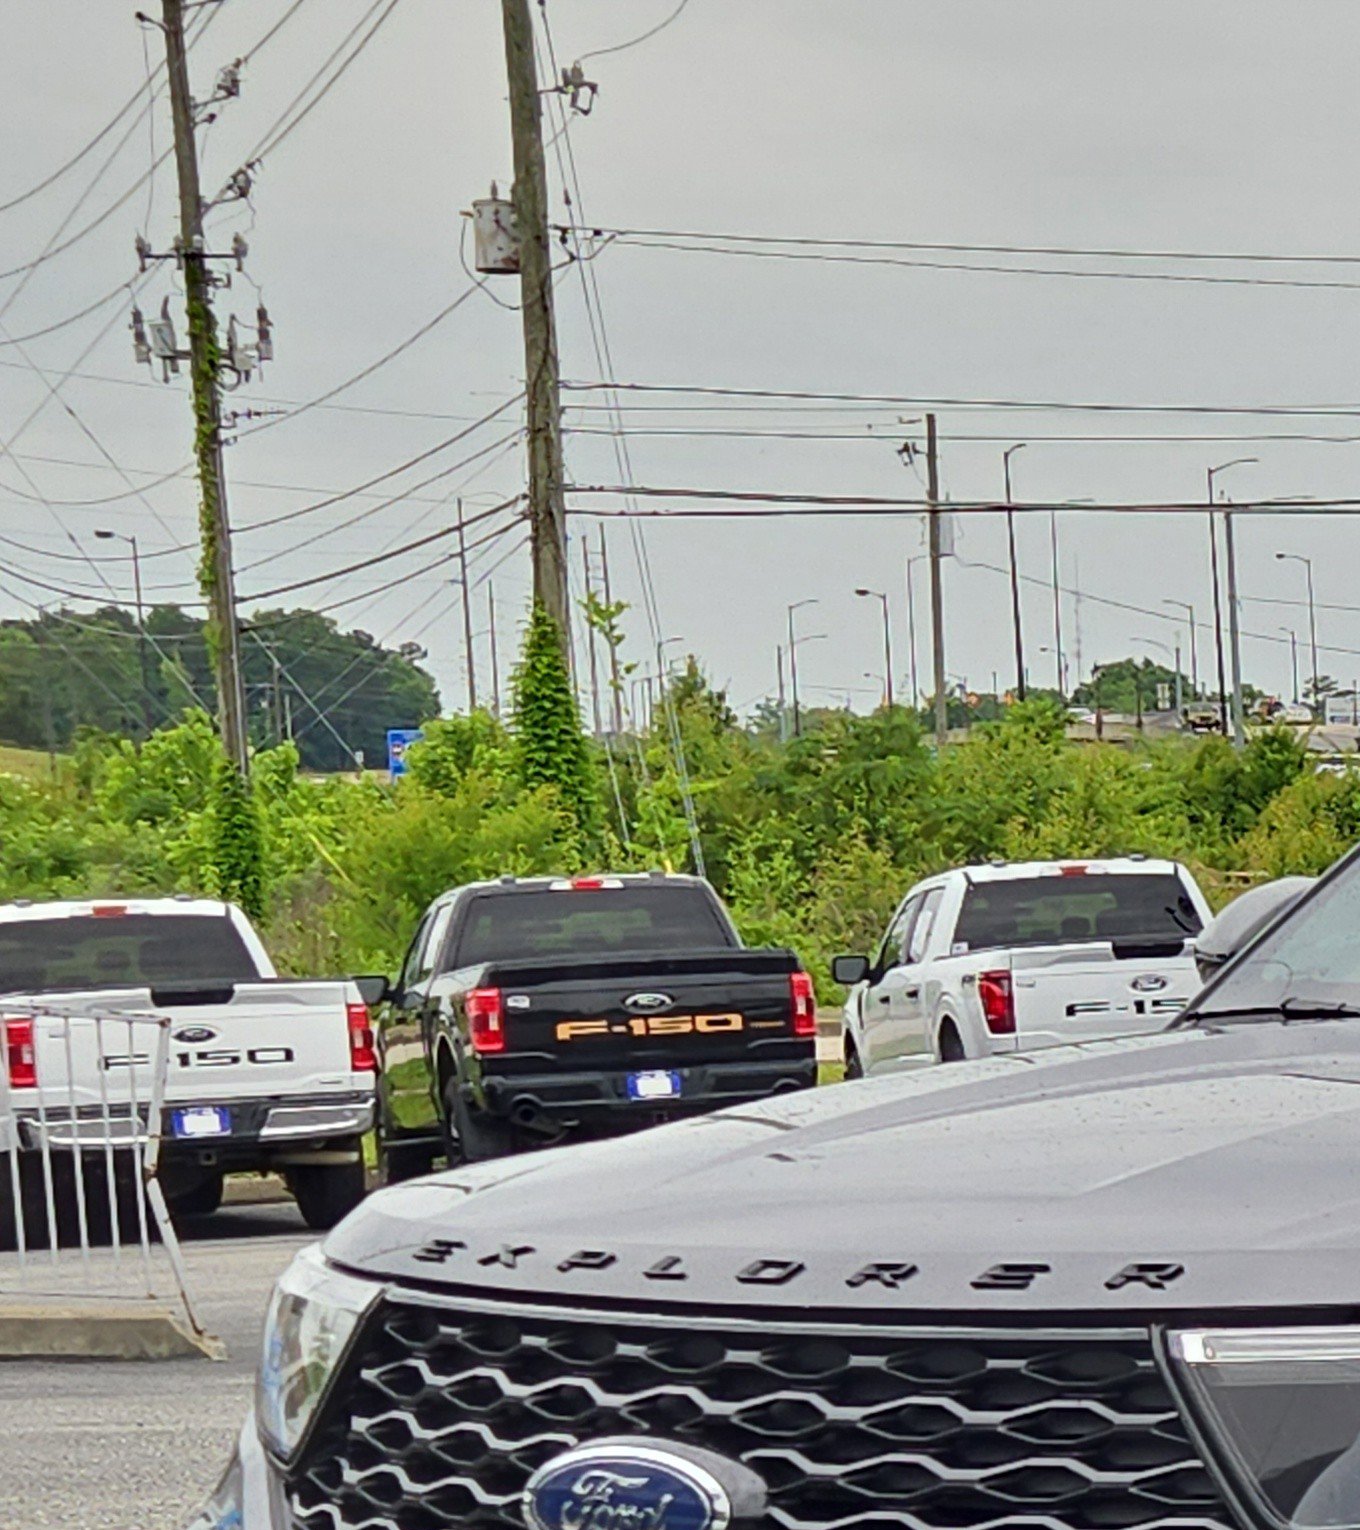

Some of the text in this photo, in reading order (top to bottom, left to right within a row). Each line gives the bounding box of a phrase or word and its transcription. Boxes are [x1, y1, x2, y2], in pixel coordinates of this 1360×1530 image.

[1065, 997, 1190, 1017] F-15
[556, 1013, 744, 1041] F-150
[412, 1238, 1186, 1290] EXPLORER
